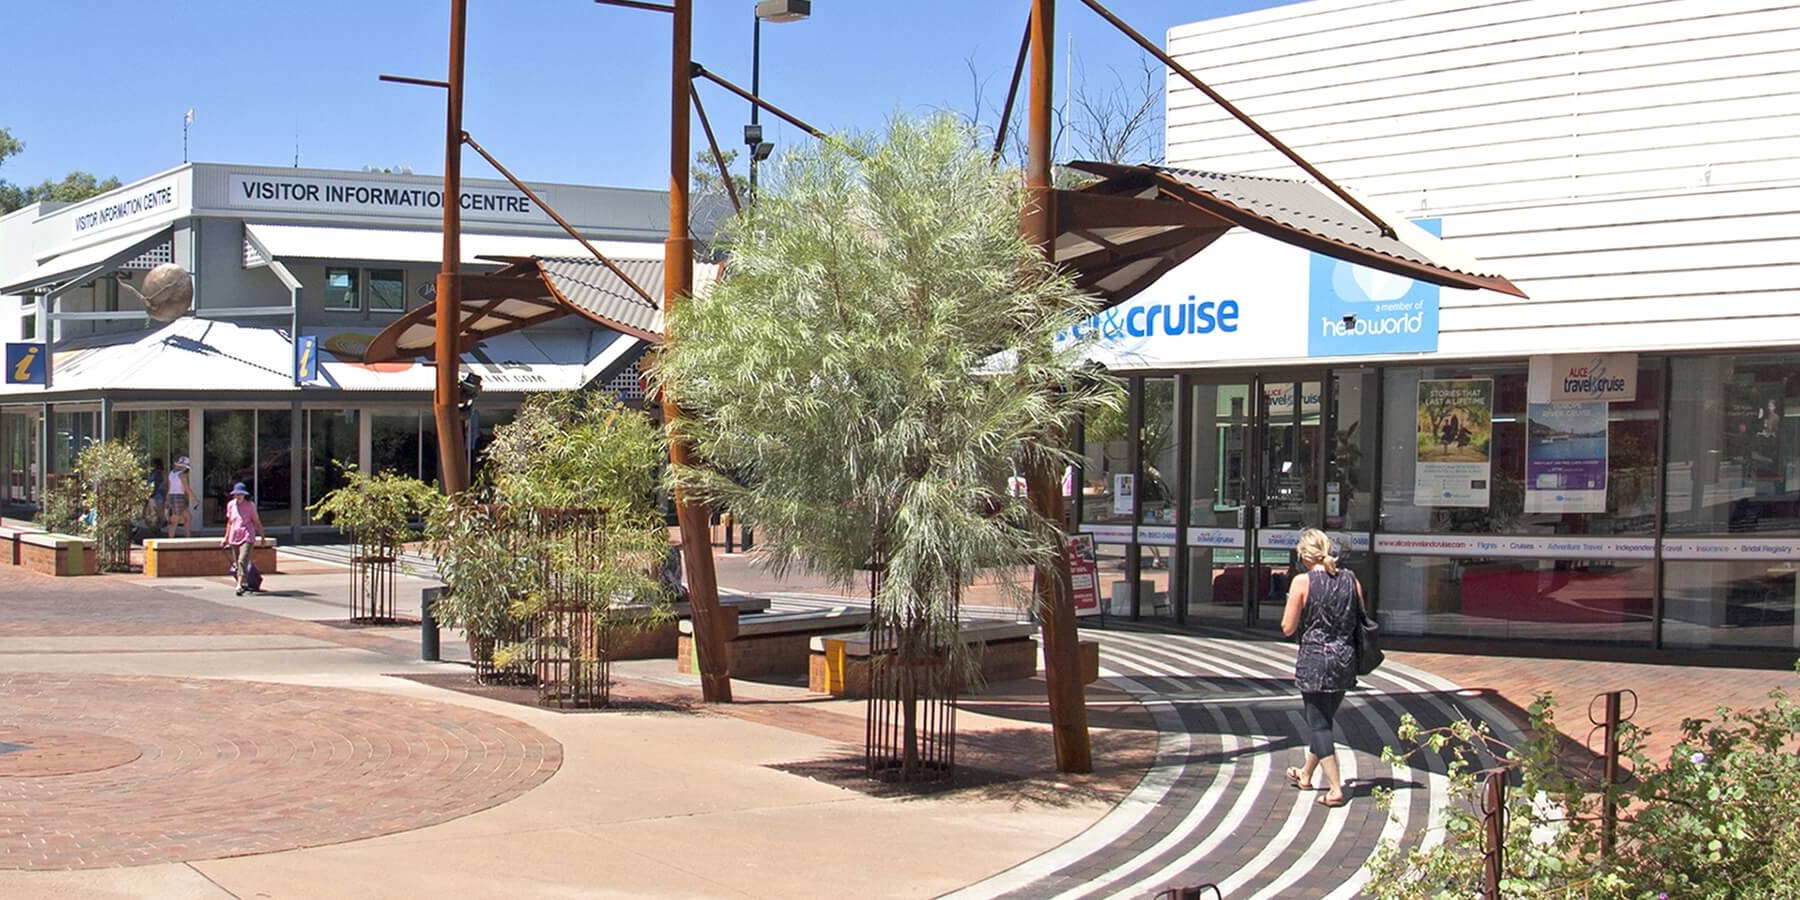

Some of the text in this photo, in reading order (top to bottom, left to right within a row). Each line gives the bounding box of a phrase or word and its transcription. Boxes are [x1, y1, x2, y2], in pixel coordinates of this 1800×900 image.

[242, 181, 320, 201] VISITOR
[458, 193, 530, 213] CENTRE
[74, 186, 172, 232] VISITOR INFORMATION CENTRE
[1381, 301, 1413, 312] member
[1414, 300, 1424, 310] of
[1569, 367, 1589, 378] ALICE
[1430, 389, 1461, 397] STORIES
[1509, 541, 1534, 550] Cruises
[1546, 542, 1581, 551] Adventure
[1696, 544, 1729, 552] Insurance
[1762, 544, 1792, 554] Registry
